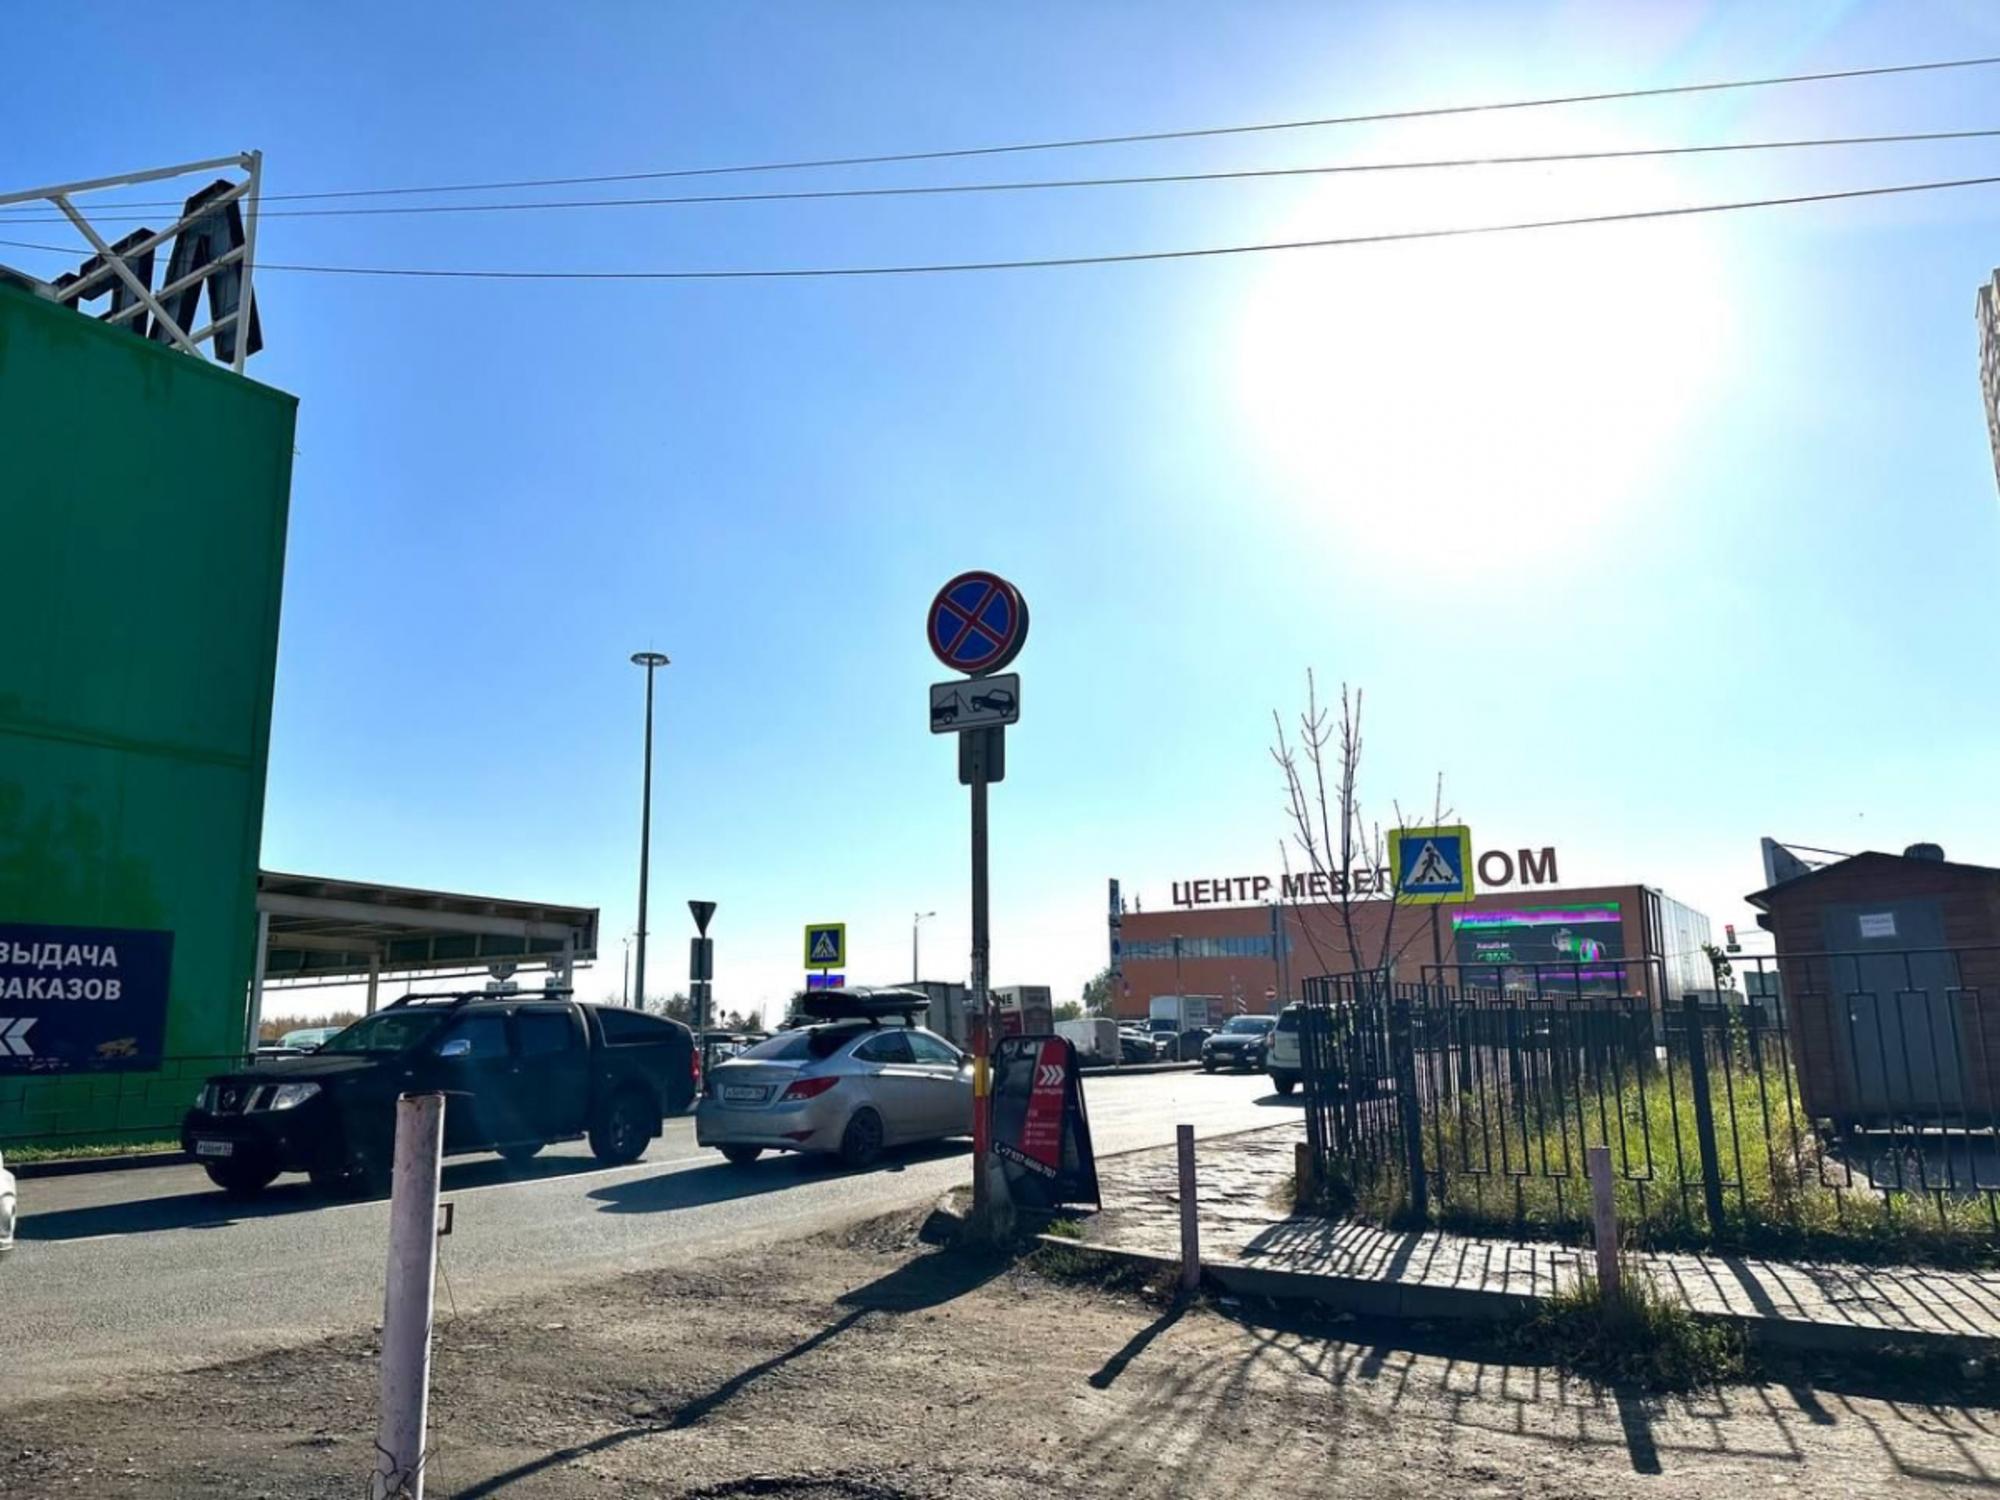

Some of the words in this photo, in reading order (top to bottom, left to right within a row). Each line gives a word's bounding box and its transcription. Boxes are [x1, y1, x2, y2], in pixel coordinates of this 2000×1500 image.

[1172, 875, 1270, 909] ЦЕНТР
[1281, 866, 1393, 899] МЕБЕЛ
[1477, 846, 1559, 888] ОМ
[0, 942, 118, 971] ВЫДАЧА
[0, 977, 121, 1000] АКАЗОВ
